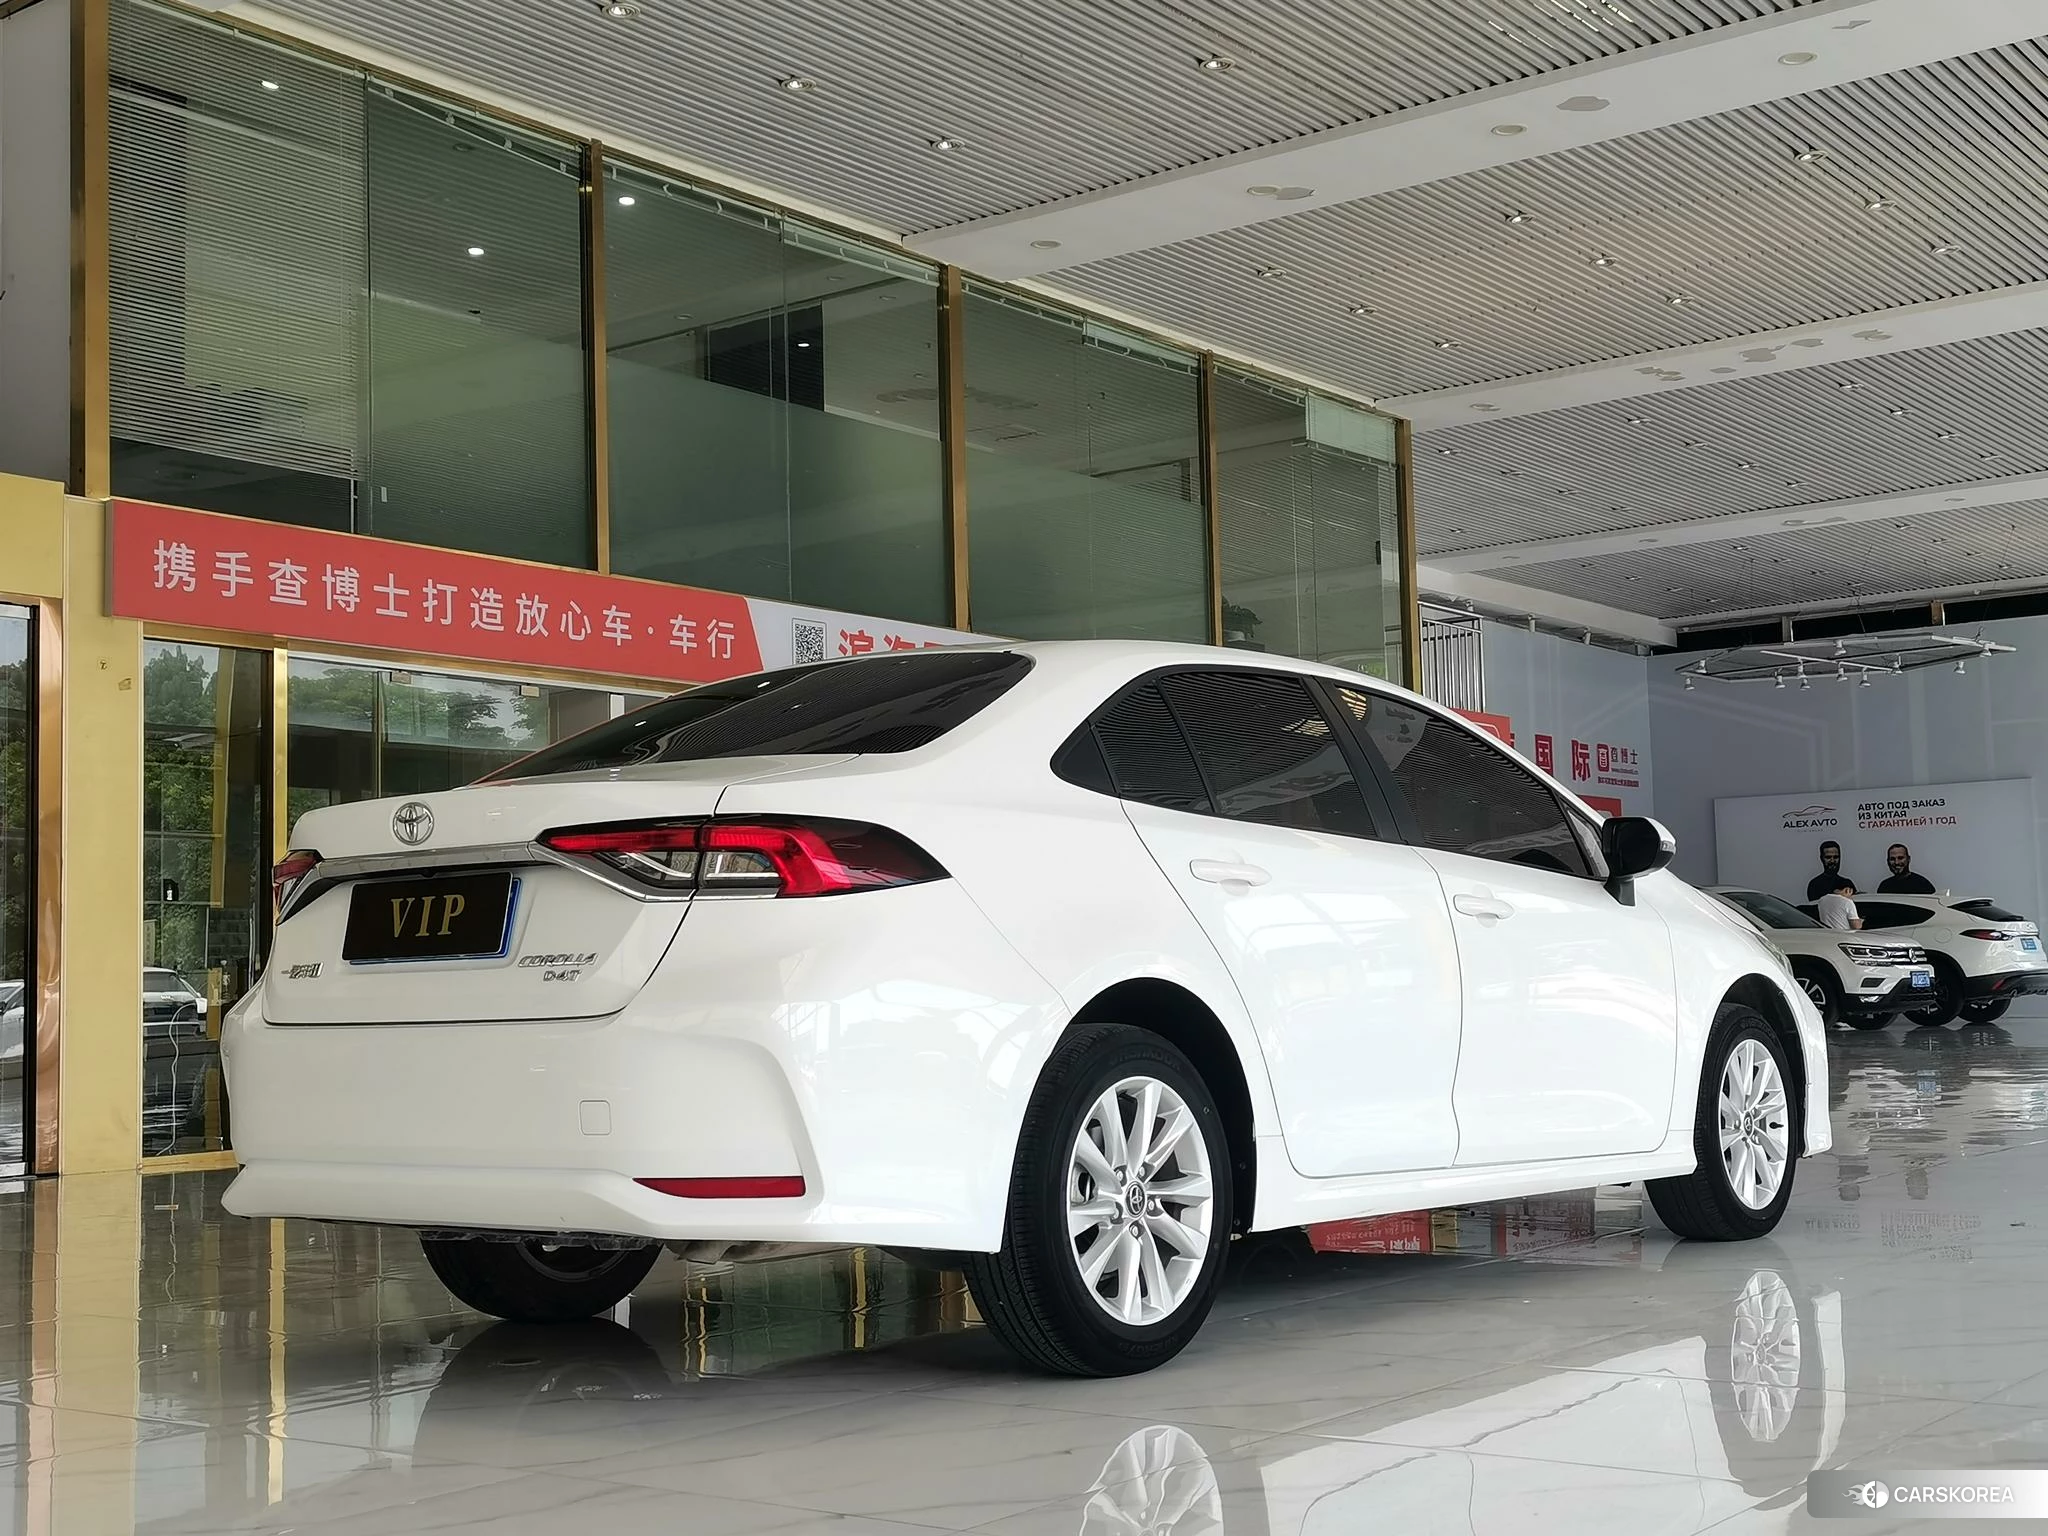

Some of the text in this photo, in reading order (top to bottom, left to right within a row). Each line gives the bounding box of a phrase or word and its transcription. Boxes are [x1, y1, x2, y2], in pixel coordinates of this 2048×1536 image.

[153, 539, 735, 659] 携手查博士打造放心车·车行
[1511, 733, 1592, 781] 国际
[1858, 799, 1946, 812] АВТО ПОД ЗАКАЗ
[1858, 810, 1907, 821] ИЗ КИТАЯ
[1859, 821, 1866, 829] С
[1868, 817, 1927, 828] ГАРАНТИЕЙ
[1936, 816, 1957, 825] ГОД
[1783, 818, 1838, 829] ALEX AVTO
[391, 894, 466, 939] VIP
[518, 953, 598, 968] COROLLA
